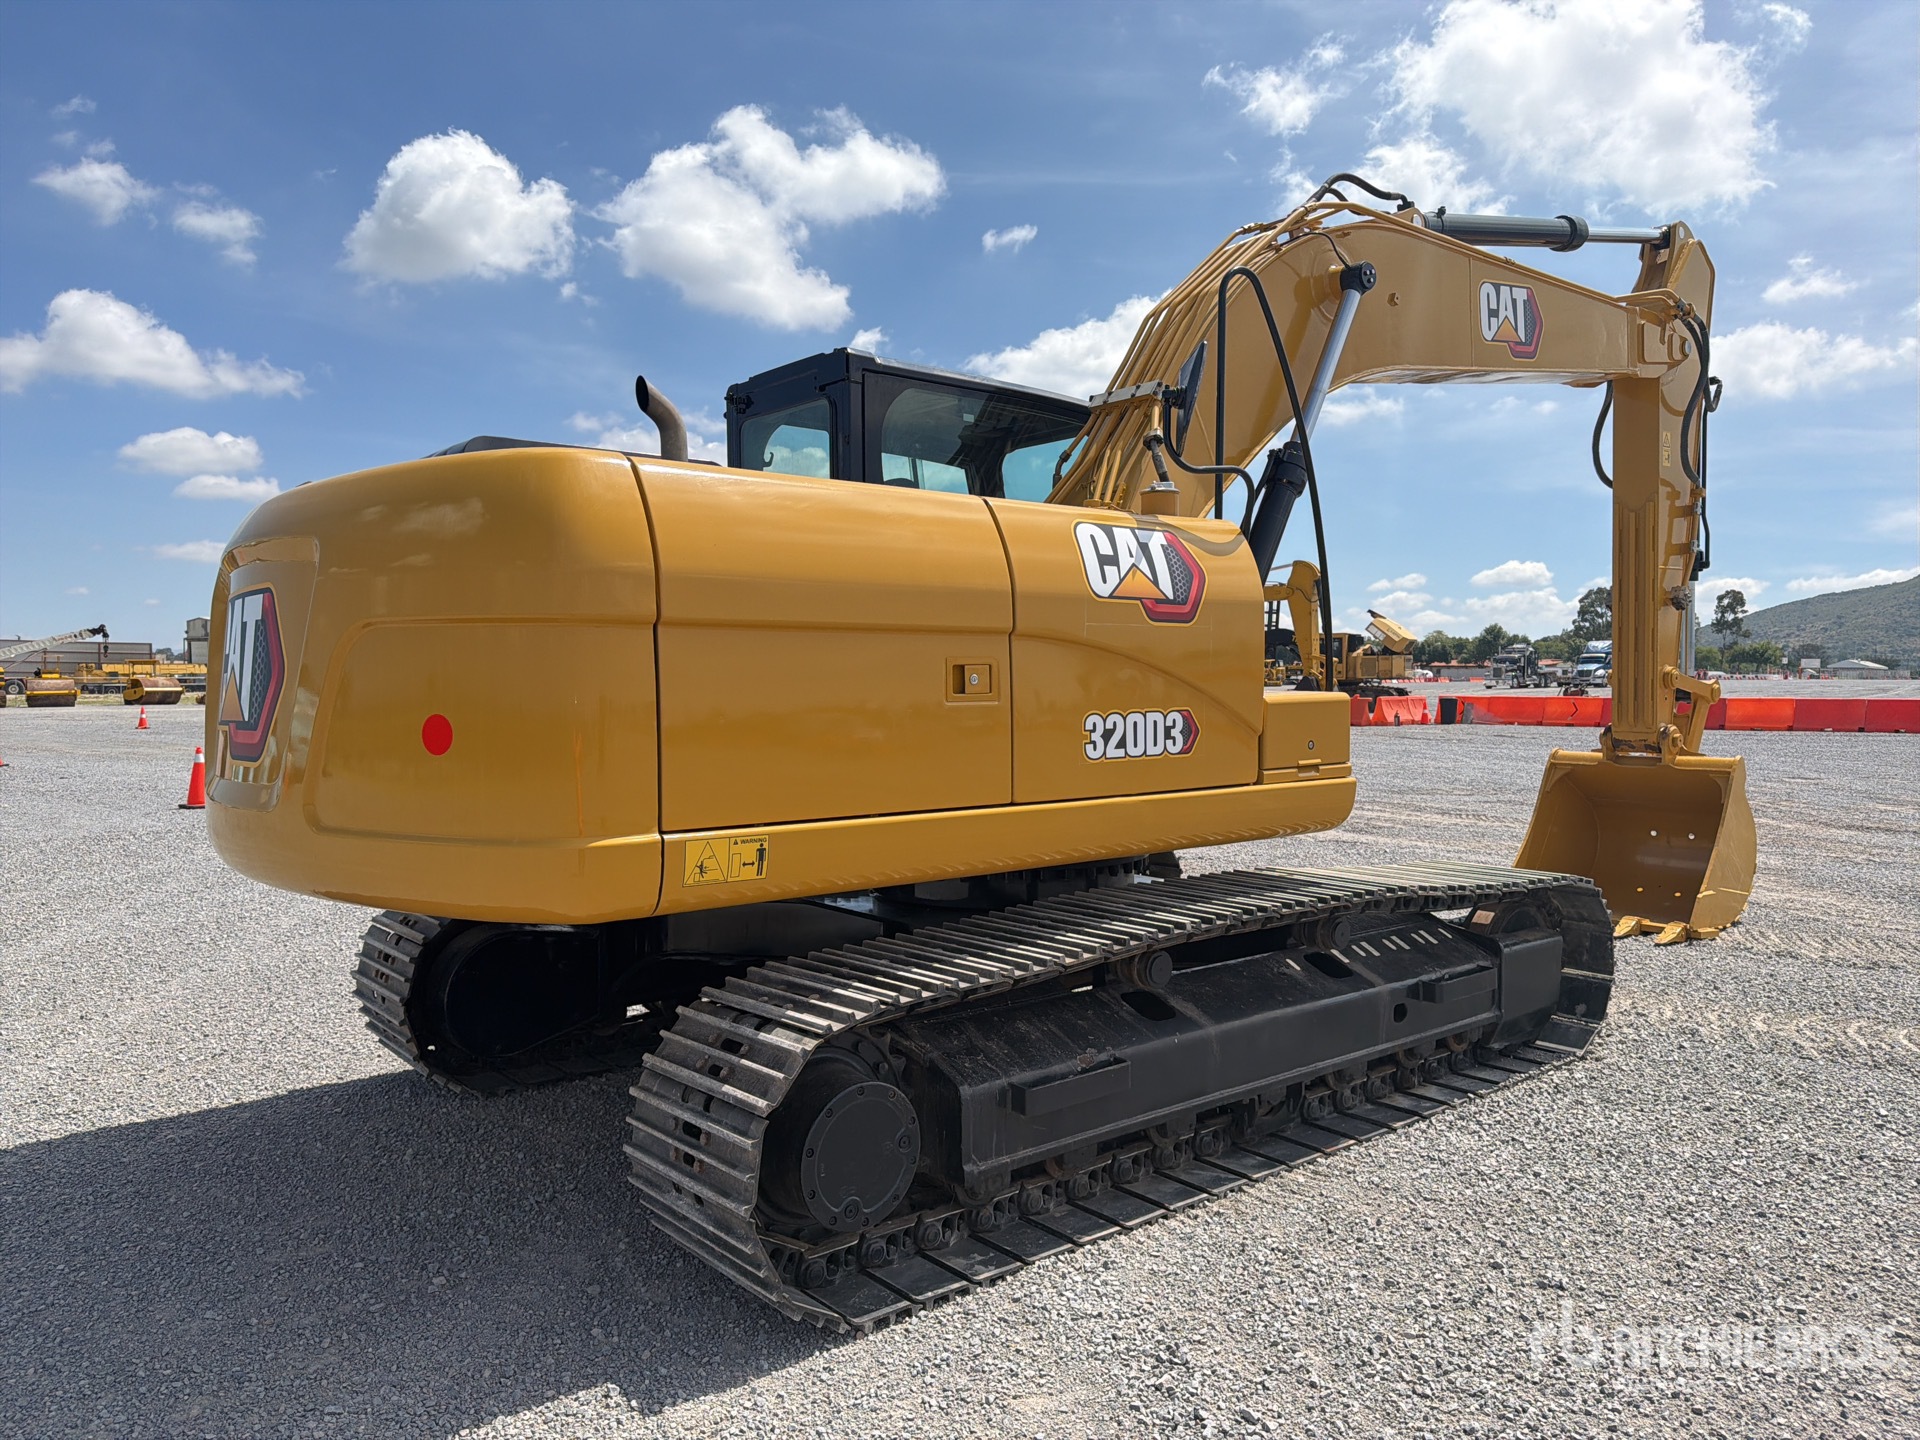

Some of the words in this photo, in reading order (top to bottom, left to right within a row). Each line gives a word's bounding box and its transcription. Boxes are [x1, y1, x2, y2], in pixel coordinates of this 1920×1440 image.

[1480, 282, 1528, 343] CAT
[1075, 522, 1175, 600] CAT
[221, 593, 264, 722] AT
[1084, 710, 1184, 760] 320D3
